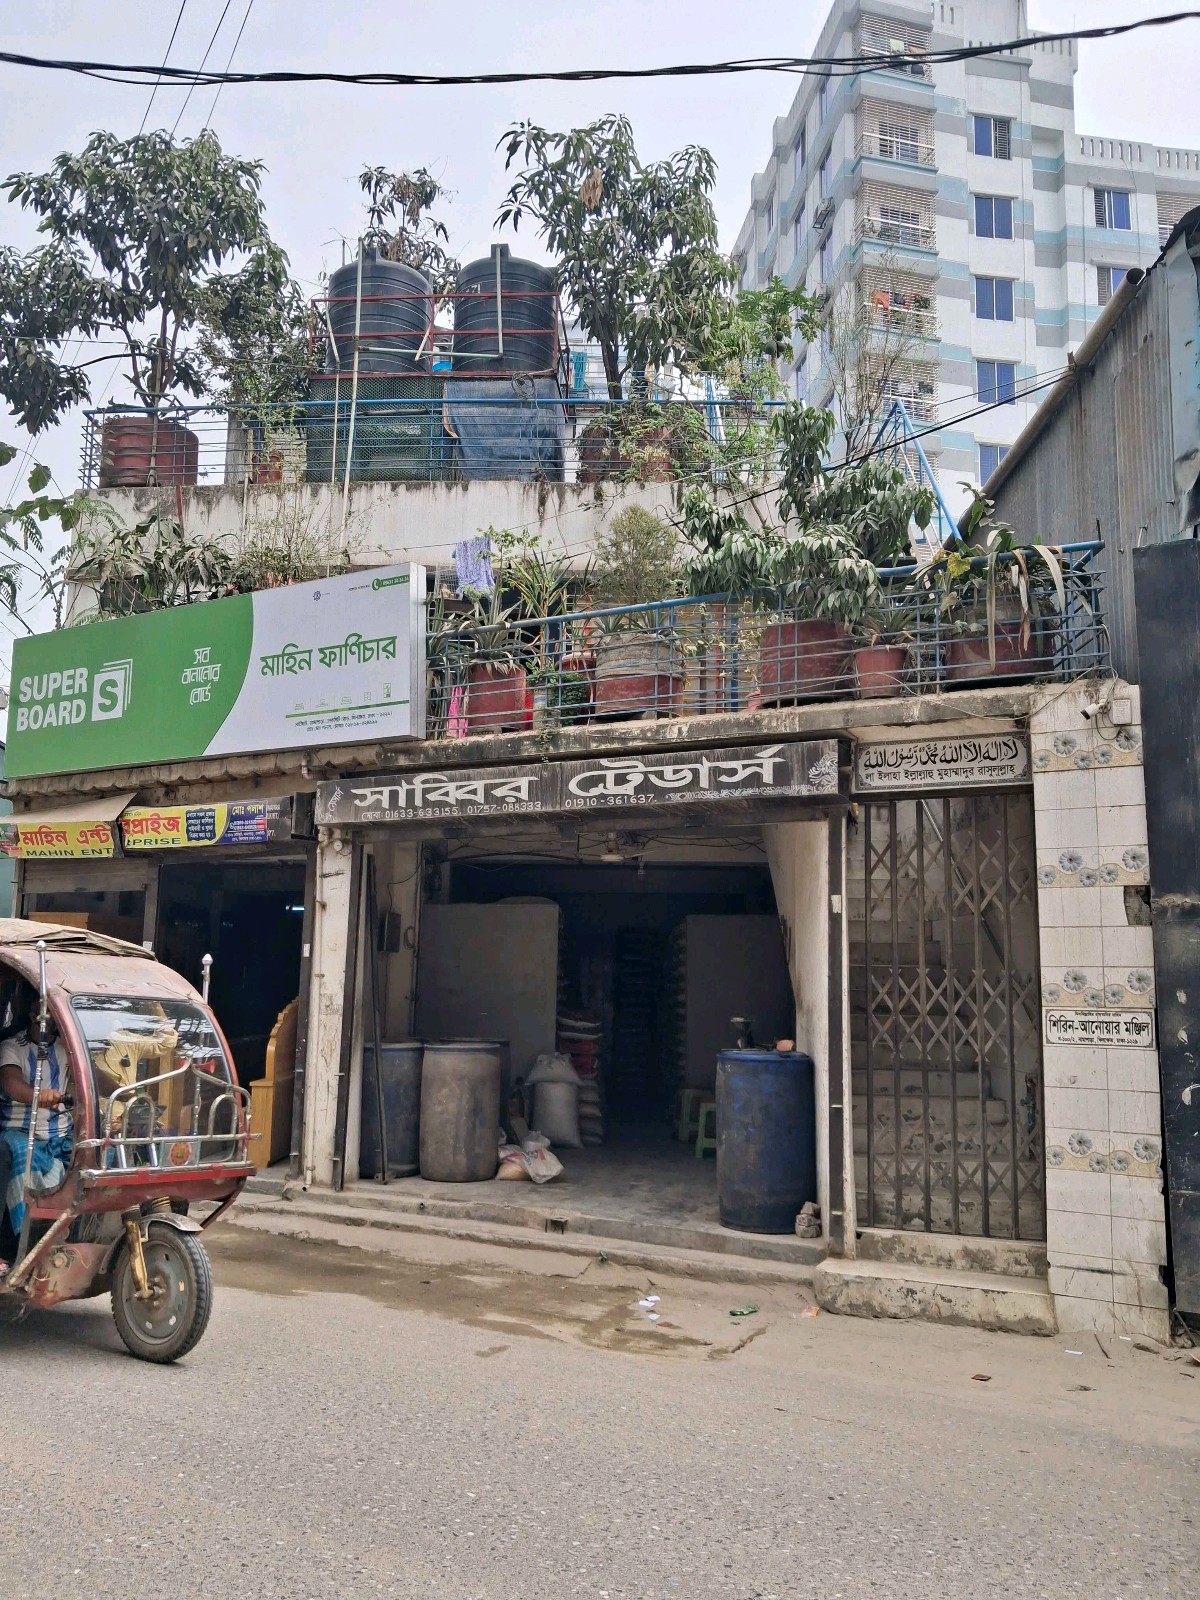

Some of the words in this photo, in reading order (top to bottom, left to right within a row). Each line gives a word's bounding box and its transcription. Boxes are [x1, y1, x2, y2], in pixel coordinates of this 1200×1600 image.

[193, 647, 211, 664] সব
[260, 643, 313, 676] মাহিন
[318, 633, 397, 668] ফার্ণিচার
[19, 667, 88, 702] SUPER
[182, 664, 221, 684] বানানোর
[98, 679, 119, 713] S
[190, 683, 211, 705] বোর্ড
[16, 699, 86, 731] BOARD
[350, 772, 540, 809] সাব্বির
[568, 744, 786, 797] ট্রেডার্স
[865, 772, 875, 782] লা
[877, 770, 901, 781] ইলাহা
[20, 825, 68, 847] মাহিন
[81, 848, 113, 856] ENT
[1048, 1014, 1121, 1035] শিরিন-আনোয়ার
[1124, 1016, 1150, 1037] মঞ্জিল
